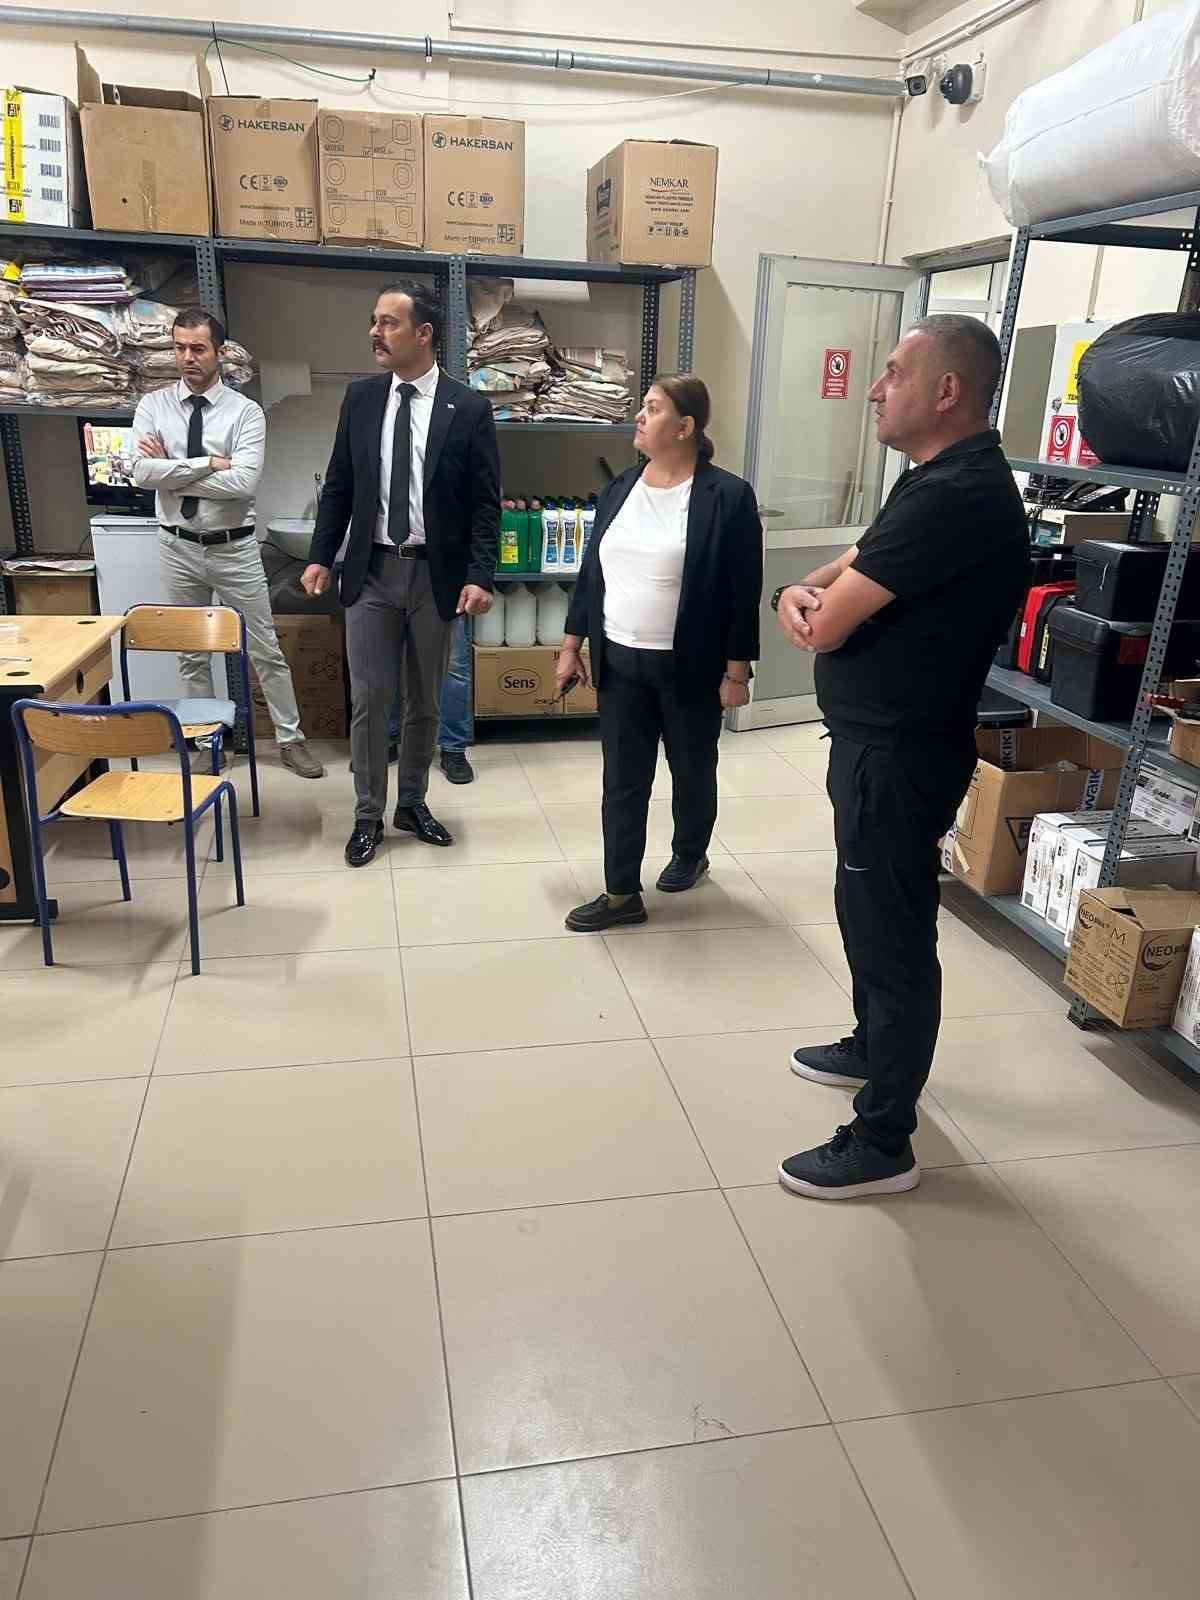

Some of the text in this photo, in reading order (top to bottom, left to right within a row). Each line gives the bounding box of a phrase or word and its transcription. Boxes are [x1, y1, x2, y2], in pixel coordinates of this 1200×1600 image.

[238, 119, 305, 132] HAKERSAN
[450, 136, 513, 151] HAKERSAN
[240, 174, 258, 190] CE
[650, 176, 689, 189] NEMKAR
[448, 191, 465, 207] CE
[504, 675, 536, 689] Sens
[1110, 927, 1126, 945] M
